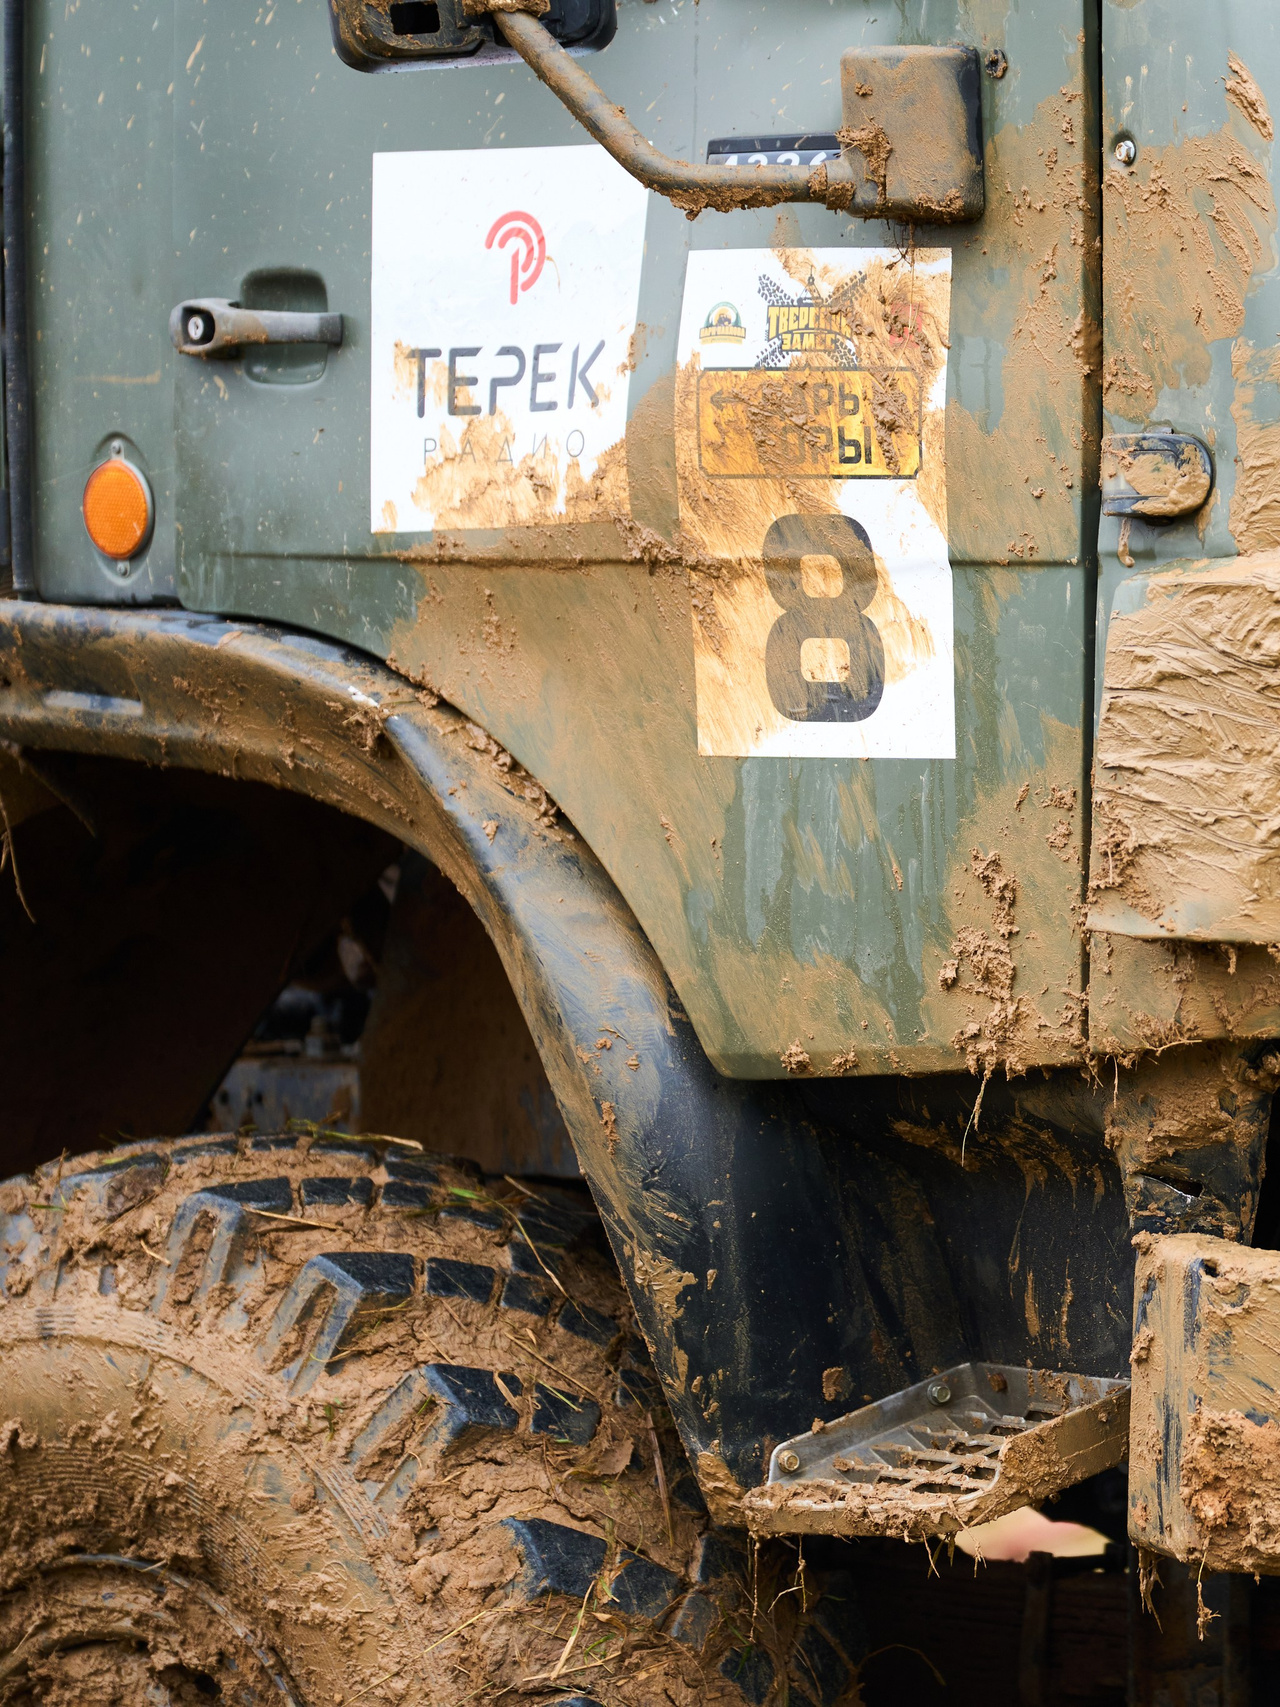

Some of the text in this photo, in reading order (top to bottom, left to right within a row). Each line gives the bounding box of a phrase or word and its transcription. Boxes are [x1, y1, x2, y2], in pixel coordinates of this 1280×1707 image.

[781, 333, 836, 350] ЗАМЕС
[404, 339, 606, 419] ТЕРЕК
[423, 429, 585, 466] РАДИО
[762, 513, 886, 723] 8
